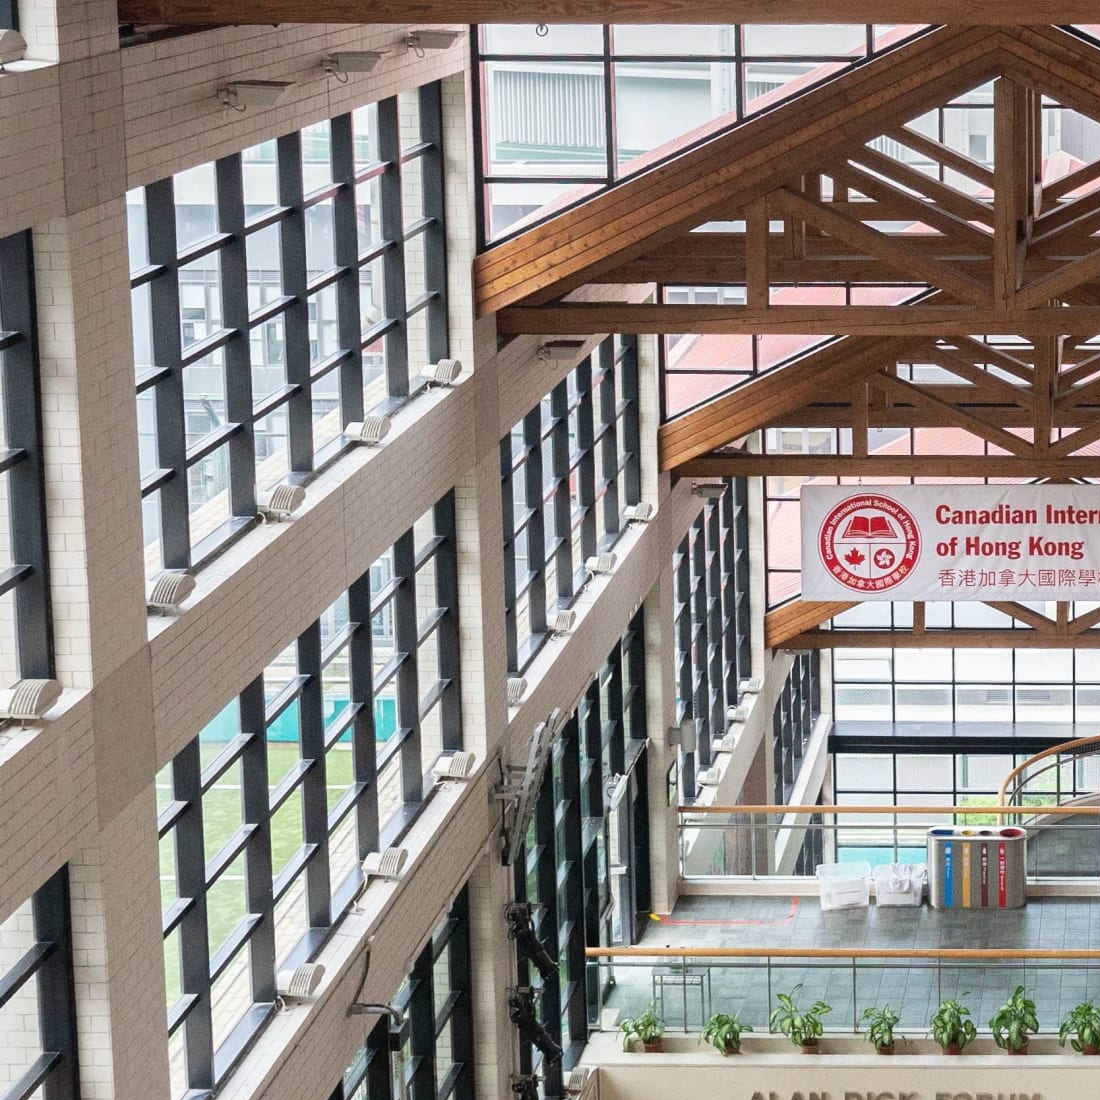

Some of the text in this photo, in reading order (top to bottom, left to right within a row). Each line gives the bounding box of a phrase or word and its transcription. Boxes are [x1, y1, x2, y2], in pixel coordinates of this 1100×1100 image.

[935, 504, 1038, 525] Canadian
[824, 526, 834, 560] Canadian
[831, 499, 872, 526] International
[873, 499, 898, 515] School
[897, 513, 906, 521] of
[936, 536, 1085, 560] of Hong Kong
